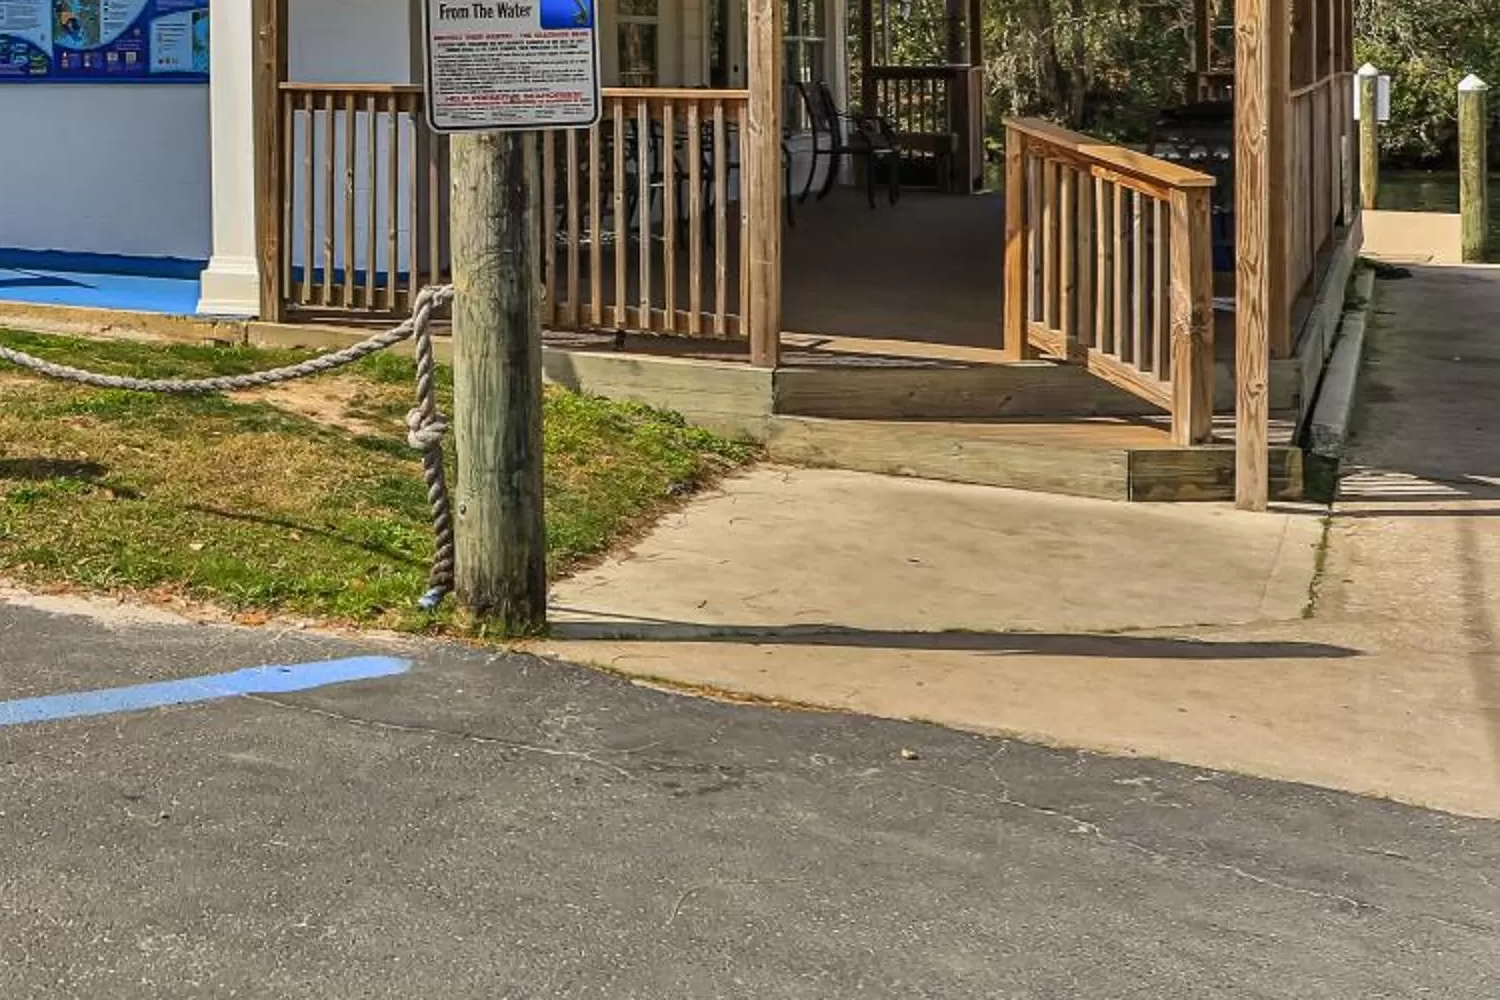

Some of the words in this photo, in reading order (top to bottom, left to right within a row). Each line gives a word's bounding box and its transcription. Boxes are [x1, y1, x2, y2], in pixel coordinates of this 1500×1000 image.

[439, 3, 469, 20] From
[472, 3, 493, 18] The
[497, 1, 532, 18] Water
